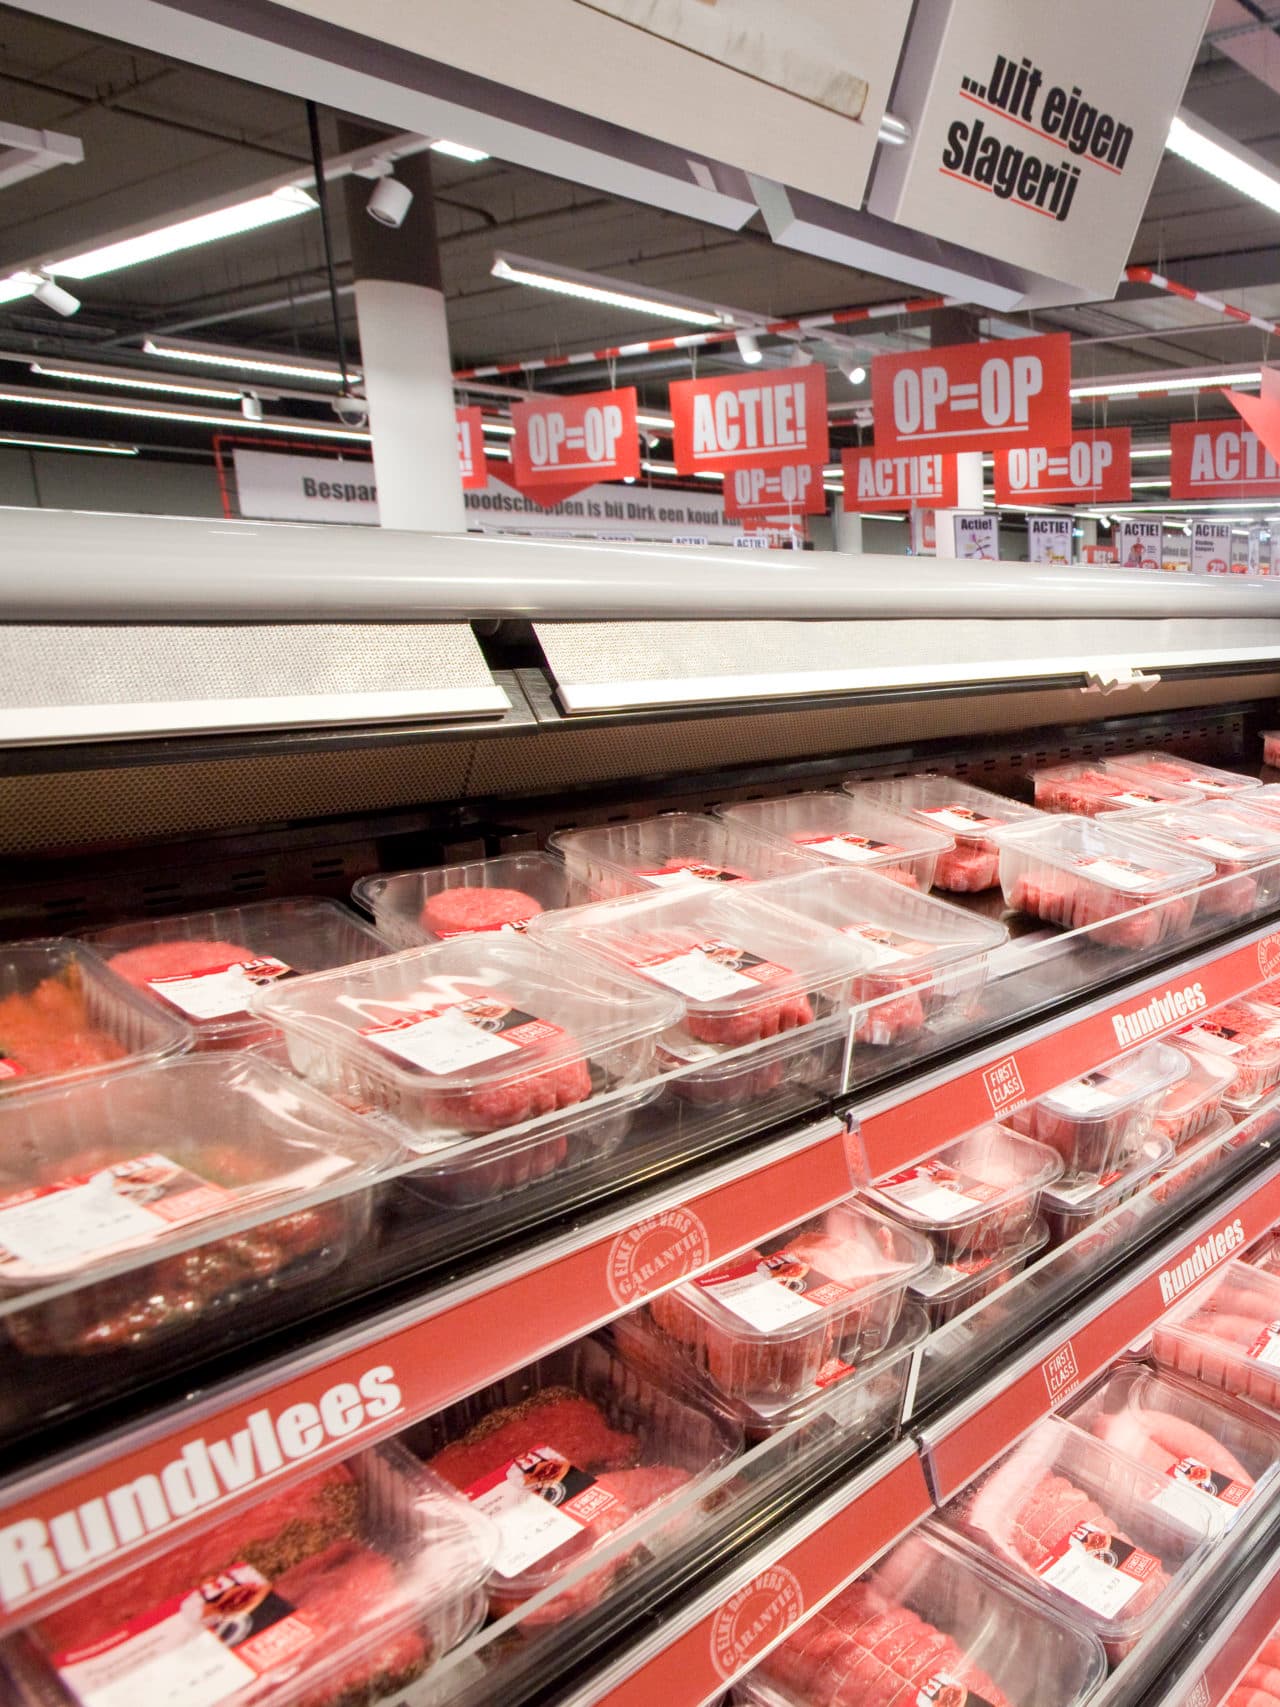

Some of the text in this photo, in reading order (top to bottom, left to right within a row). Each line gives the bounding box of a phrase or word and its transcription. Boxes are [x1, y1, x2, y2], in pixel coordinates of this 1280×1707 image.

[1040, 86, 1133, 169] eigen
[942, 119, 1081, 222] slagerij
[693, 382, 807, 452] ACTIE!
[893, 355, 1043, 434] OP=OP
[528, 405, 623, 465] OP=OP
[735, 464, 812, 504] OP=OP
[857, 454, 943, 497] ACTIE!
[1008, 440, 1112, 489] OP=OP
[303, 477, 377, 502] Bespar
[588, 499, 601, 517] is
[605, 500, 623, 520] bij
[627, 502, 656, 521] Dirk
[658, 508, 684, 523] een
[687, 507, 719, 526] koud
[961, 518, 992, 531] Actie!
[1033, 520, 1069, 534] ACTIE!
[1124, 523, 1159, 537] ACTIE!
[1195, 523, 1229, 537] ACTIE!
[1111, 982, 1206, 1046] Rundvlees
[989, 1063, 1014, 1087] FIRST
[993, 1077, 1020, 1103] CLASS
[619, 1229, 701, 1295] GARANTIE
[1158, 1218, 1245, 1304] Rundvlees
[1048, 1348, 1070, 1375] FIRST
[1050, 1364, 1075, 1393] CLASS
[0, 1365, 402, 1597] Rundvlees
[722, 1583, 795, 1667] GARANTIE
